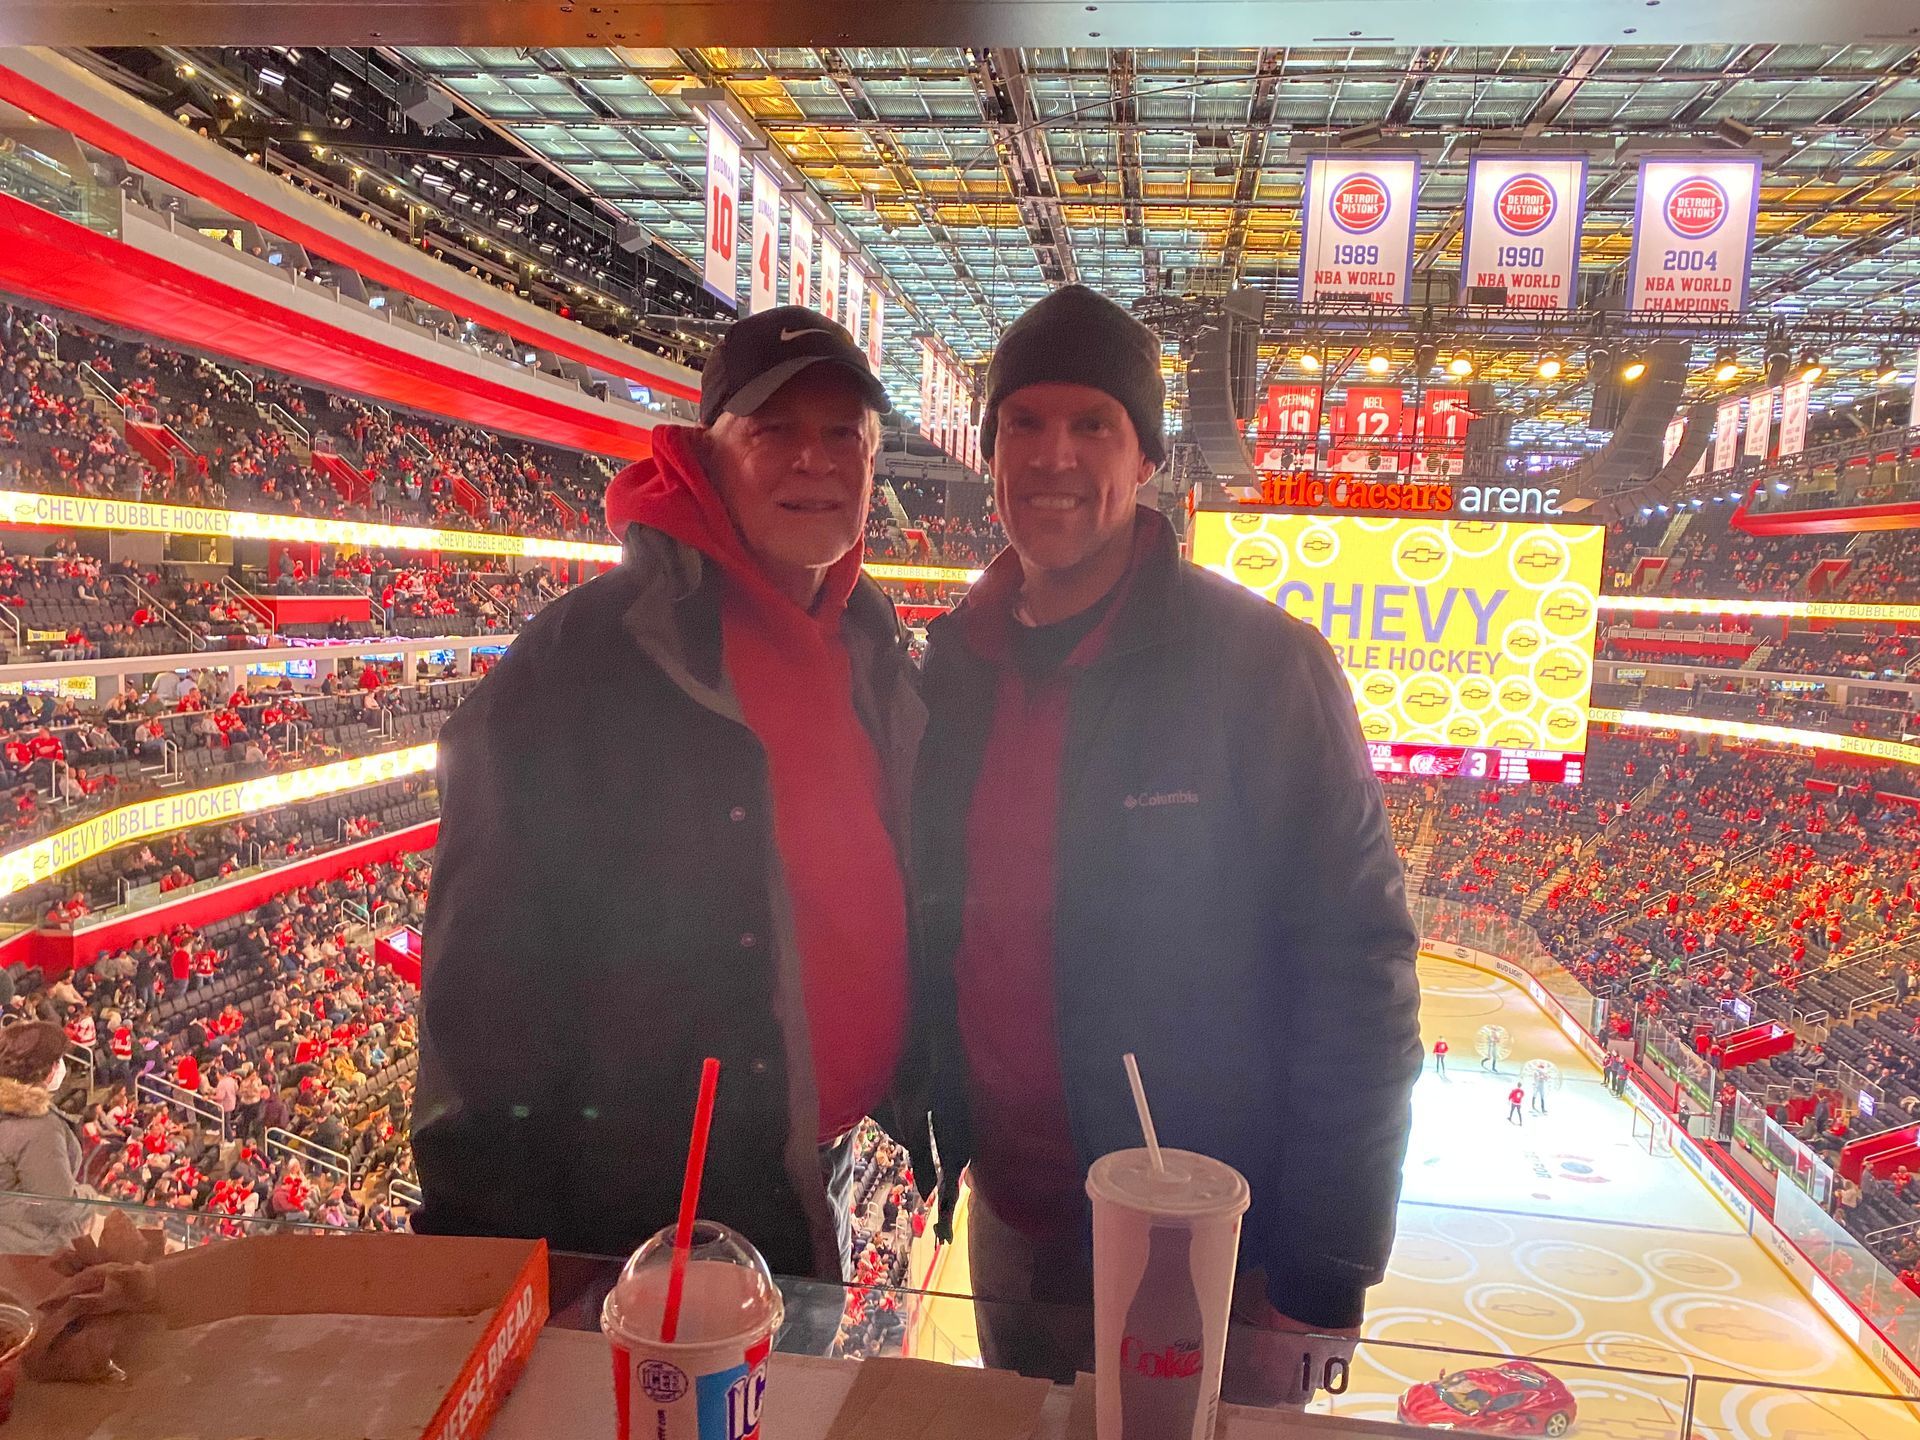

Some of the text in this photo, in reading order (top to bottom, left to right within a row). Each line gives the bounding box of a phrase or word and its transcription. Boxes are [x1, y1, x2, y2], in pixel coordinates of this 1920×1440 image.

[1342, 193, 1379, 203] DETROIT
[1508, 195, 1545, 204] DETROIT
[1678, 198, 1716, 207] DETROIT
[1341, 203, 1379, 214] PISTONS
[1506, 205, 1544, 215] PISTONS
[1676, 208, 1715, 218] PISTONS
[712, 185, 732, 262] 10
[758, 232, 770, 292] 4
[1334, 245, 1379, 265] 1989
[1497, 247, 1544, 267] 1990
[1664, 250, 1717, 271] 2004
[1314, 271, 1395, 286] NBA WORLD
[1477, 273, 1561, 288] NBA WORLD
[1645, 277, 1732, 292] NBA WORLD
[1506, 294, 1558, 308] MPIONS
[1644, 297, 1729, 312] CHAMPIONS
[1363, 396, 1385, 409] ABEL
[1279, 410, 1310, 440] 19
[1357, 412, 1389, 442] 12
[1239, 471, 1563, 515] ittle Caesars arena
[37, 497, 232, 532] CHEVY BUBBLE HOCKEY
[439, 533, 525, 552] CHEVY BUBBLE HOCKEY
[870, 567, 968, 579] HEVY BUBBLE HOCKEY
[1276, 580, 1510, 646] CHEVY
[1806, 604, 1920, 618] CHEVY BUBBLE HOC
[1333, 645, 1503, 675] BLE HOCKEY
[1588, 709, 1625, 721] OCKEY
[1840, 737, 1875, 752] CHEVY
[1471, 752, 1487, 776] 3
[1138, 790, 1199, 807] Columbia
[52, 786, 244, 867] CHEVY BUBBLE HOCKEY
[1420, 940, 1435, 951] jer
[1496, 961, 1523, 979] BUD LIGHT
[488, 1284, 533, 1384] BREAD
[1120, 1336, 1203, 1379] Coke
[1302, 1352, 1350, 1395] 10
[1881, 1348, 1920, 1398] Huntingto
